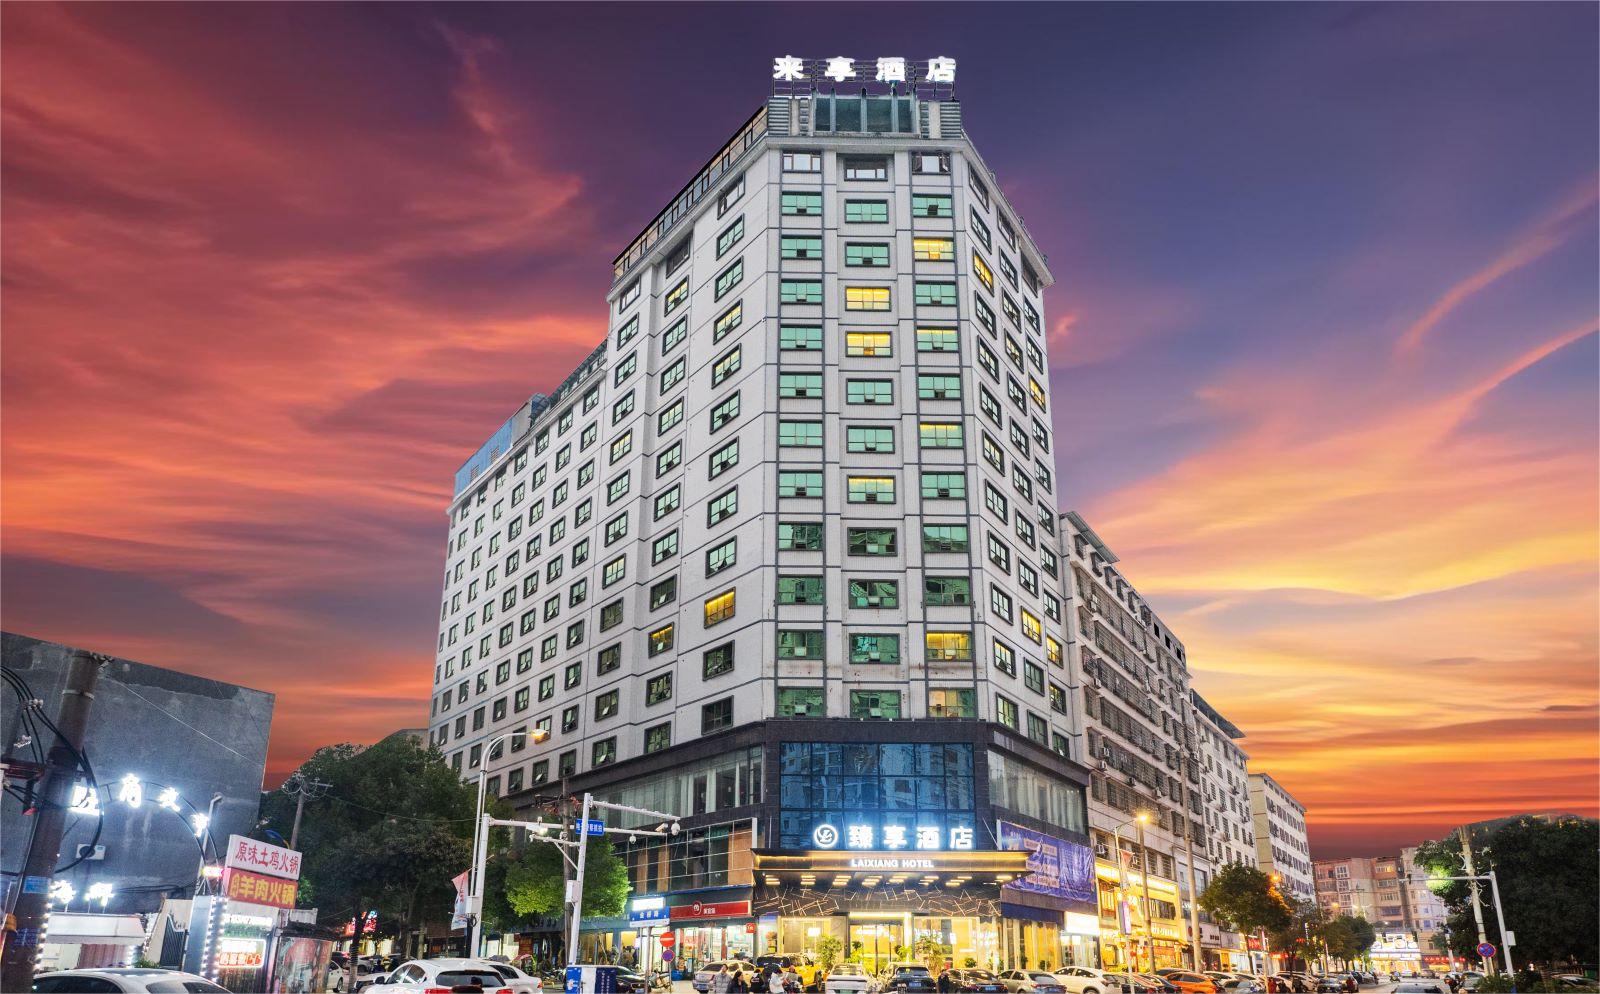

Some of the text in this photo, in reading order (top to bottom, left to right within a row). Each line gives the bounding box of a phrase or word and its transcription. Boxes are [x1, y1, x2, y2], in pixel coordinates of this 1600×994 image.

[773, 55, 956, 82] 来享酒店
[235, 841, 299, 875] 原味土鸡火锅
[851, 859, 935, 868] LAIXIANG HOTEL
